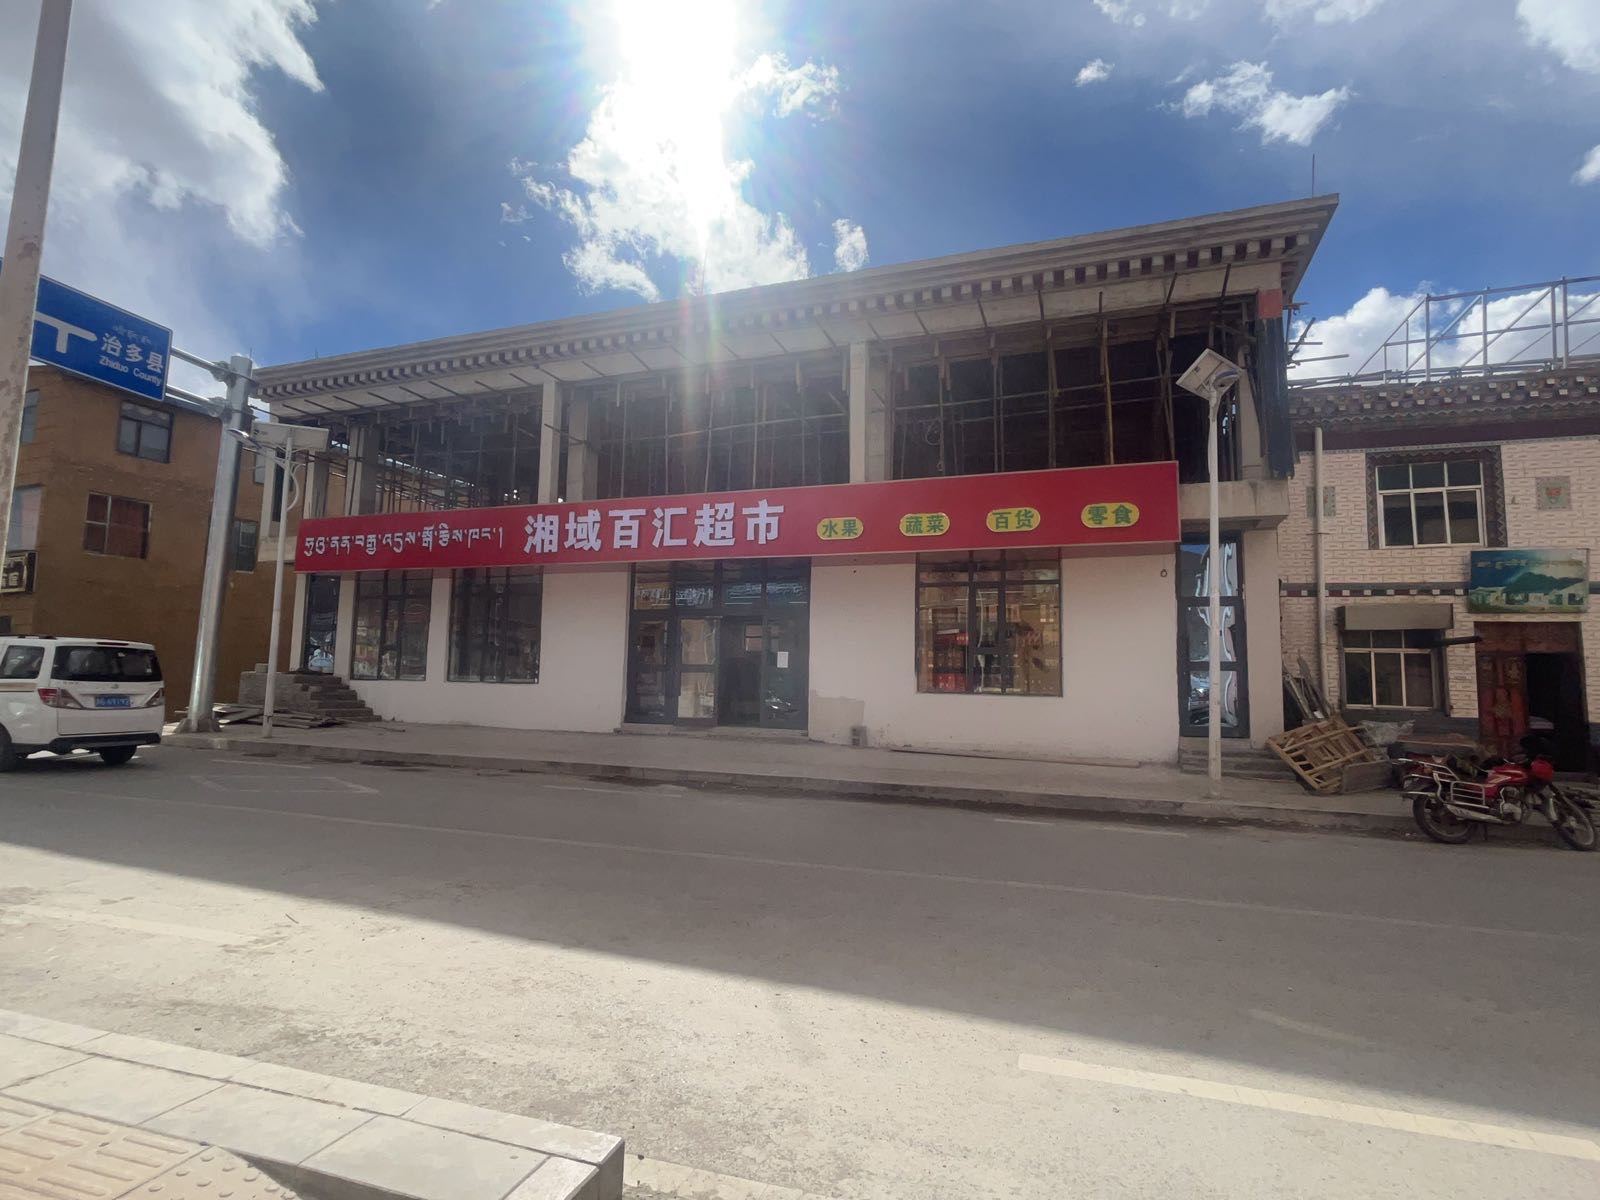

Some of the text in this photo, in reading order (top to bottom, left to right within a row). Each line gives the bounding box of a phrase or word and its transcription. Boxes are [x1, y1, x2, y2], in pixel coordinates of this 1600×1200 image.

[102, 333, 163, 373] 治多县
[99, 355, 162, 386] Zhiduo County
[905, 514, 946, 535] 蔬菜
[992, 508, 1036, 530] 百货
[1087, 504, 1134, 525] 零食
[523, 499, 785, 554] 湘域百汇超市
[822, 518, 859, 538] 水果
